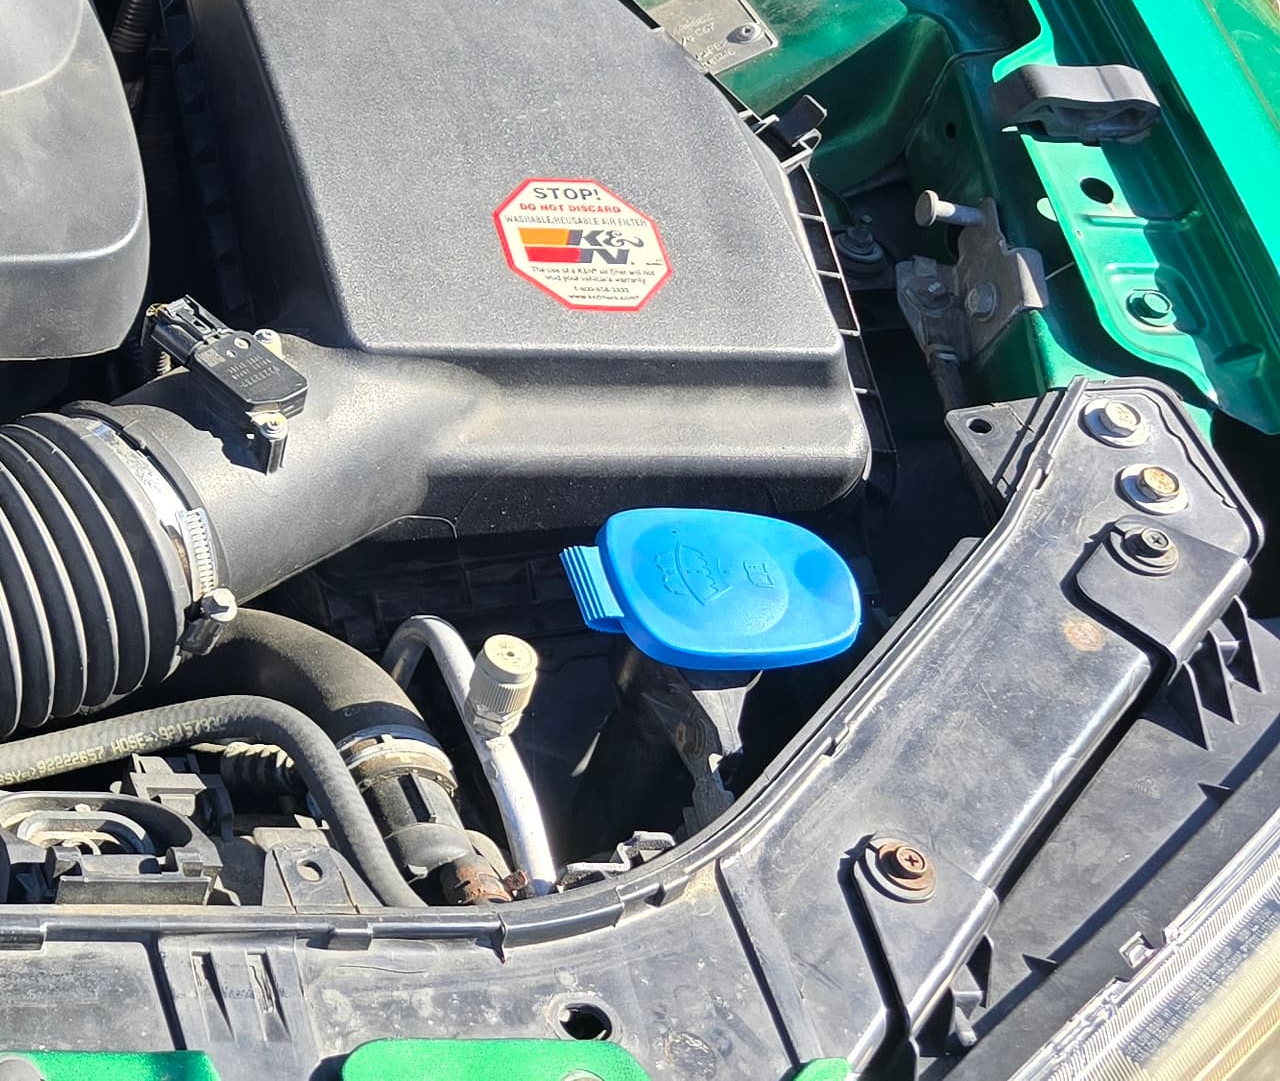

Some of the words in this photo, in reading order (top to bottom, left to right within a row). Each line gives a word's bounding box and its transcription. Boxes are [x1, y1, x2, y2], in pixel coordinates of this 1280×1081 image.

[533, 187, 601, 201] STOP!
[520, 203, 536, 211] DO
[540, 204, 564, 212] NOT
[569, 205, 622, 213] DISCARD
